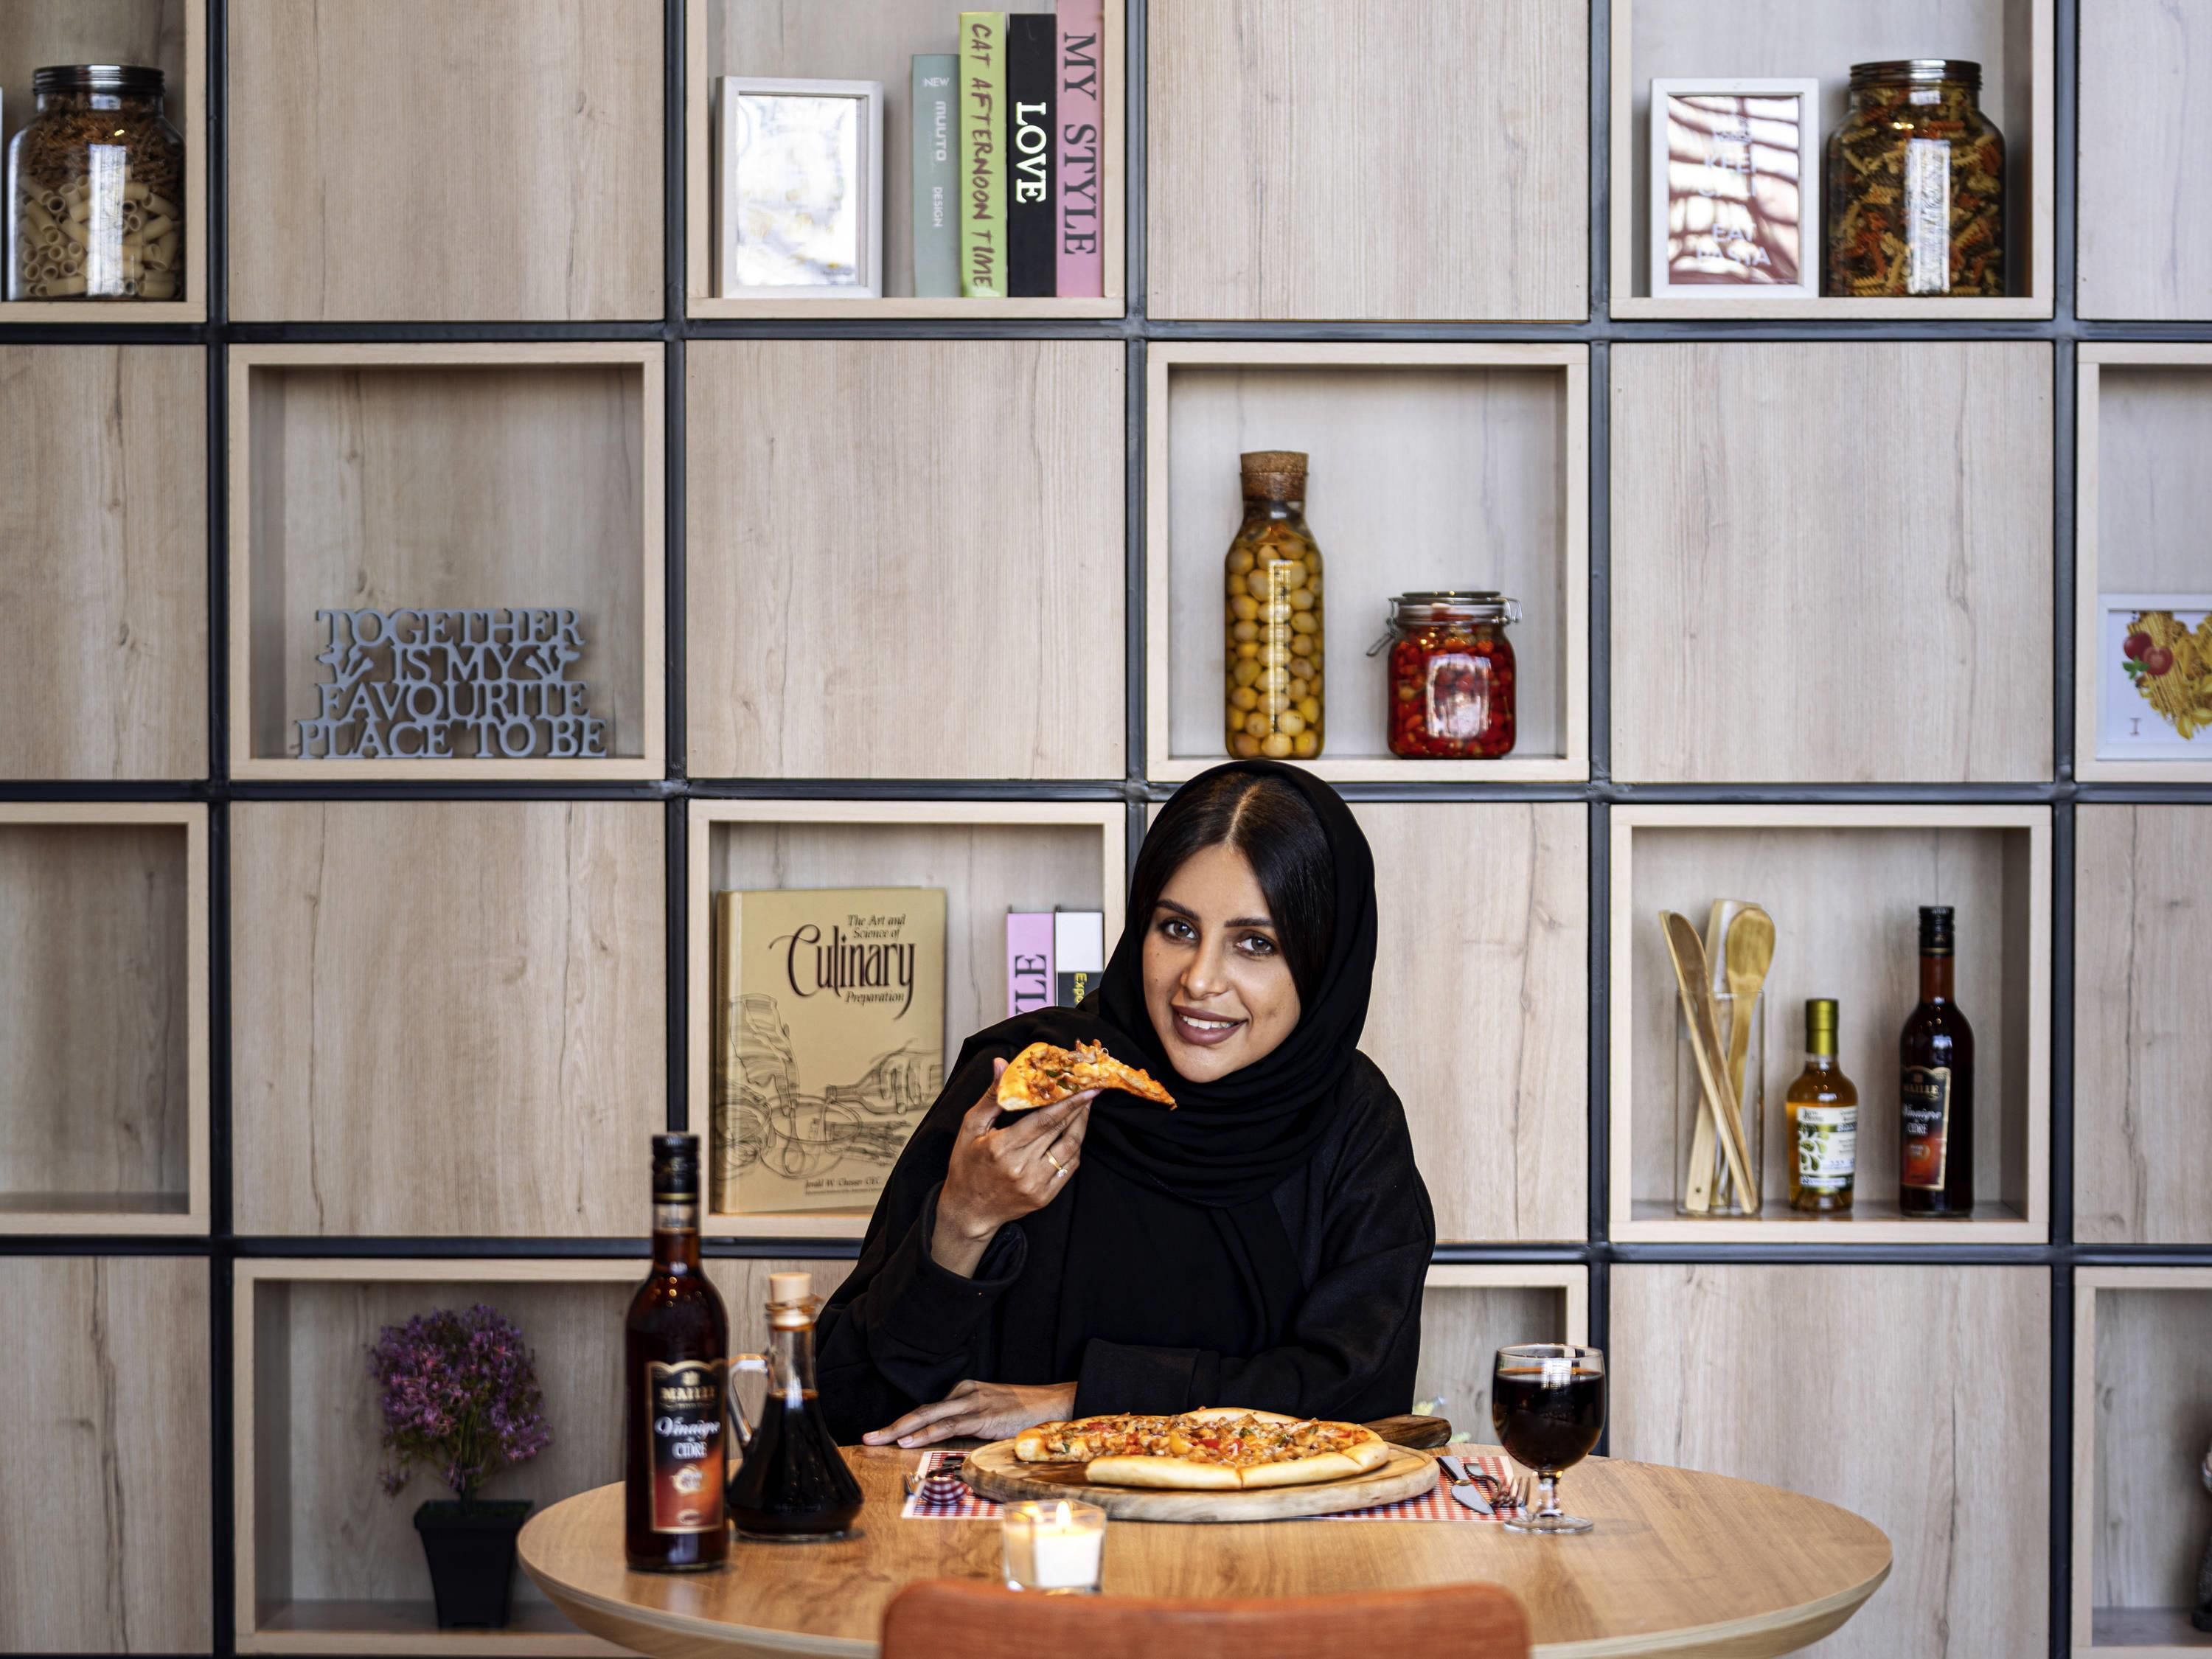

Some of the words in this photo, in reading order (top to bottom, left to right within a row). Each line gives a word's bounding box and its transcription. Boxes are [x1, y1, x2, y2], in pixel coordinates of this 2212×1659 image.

[970, 22, 993, 69] CAT
[924, 77, 950, 87] NEW
[1064, 32, 1097, 100] MY
[970, 77, 994, 220] AFTERNOON
[1015, 101, 1047, 204] LOVE
[933, 187, 943, 227] DESIGN
[1064, 123, 1098, 254] STYLE
[970, 229, 995, 289] TIME
[316, 608, 585, 647] TOGETHER
[391, 644, 432, 684] IS
[442, 644, 518, 684] MY
[316, 681, 589, 720] FAVOURITE
[295, 719, 454, 759] PLACE
[465, 719, 537, 758] TO
[543, 718, 608, 758] BE
[847, 914, 863, 927] The
[868, 915, 886, 927] Art
[887, 914, 906, 927] and
[852, 927, 887, 939] Science
[889, 928, 900, 941] of
[768, 923, 917, 1022] Culinary
[845, 991, 905, 1007] Preparation
